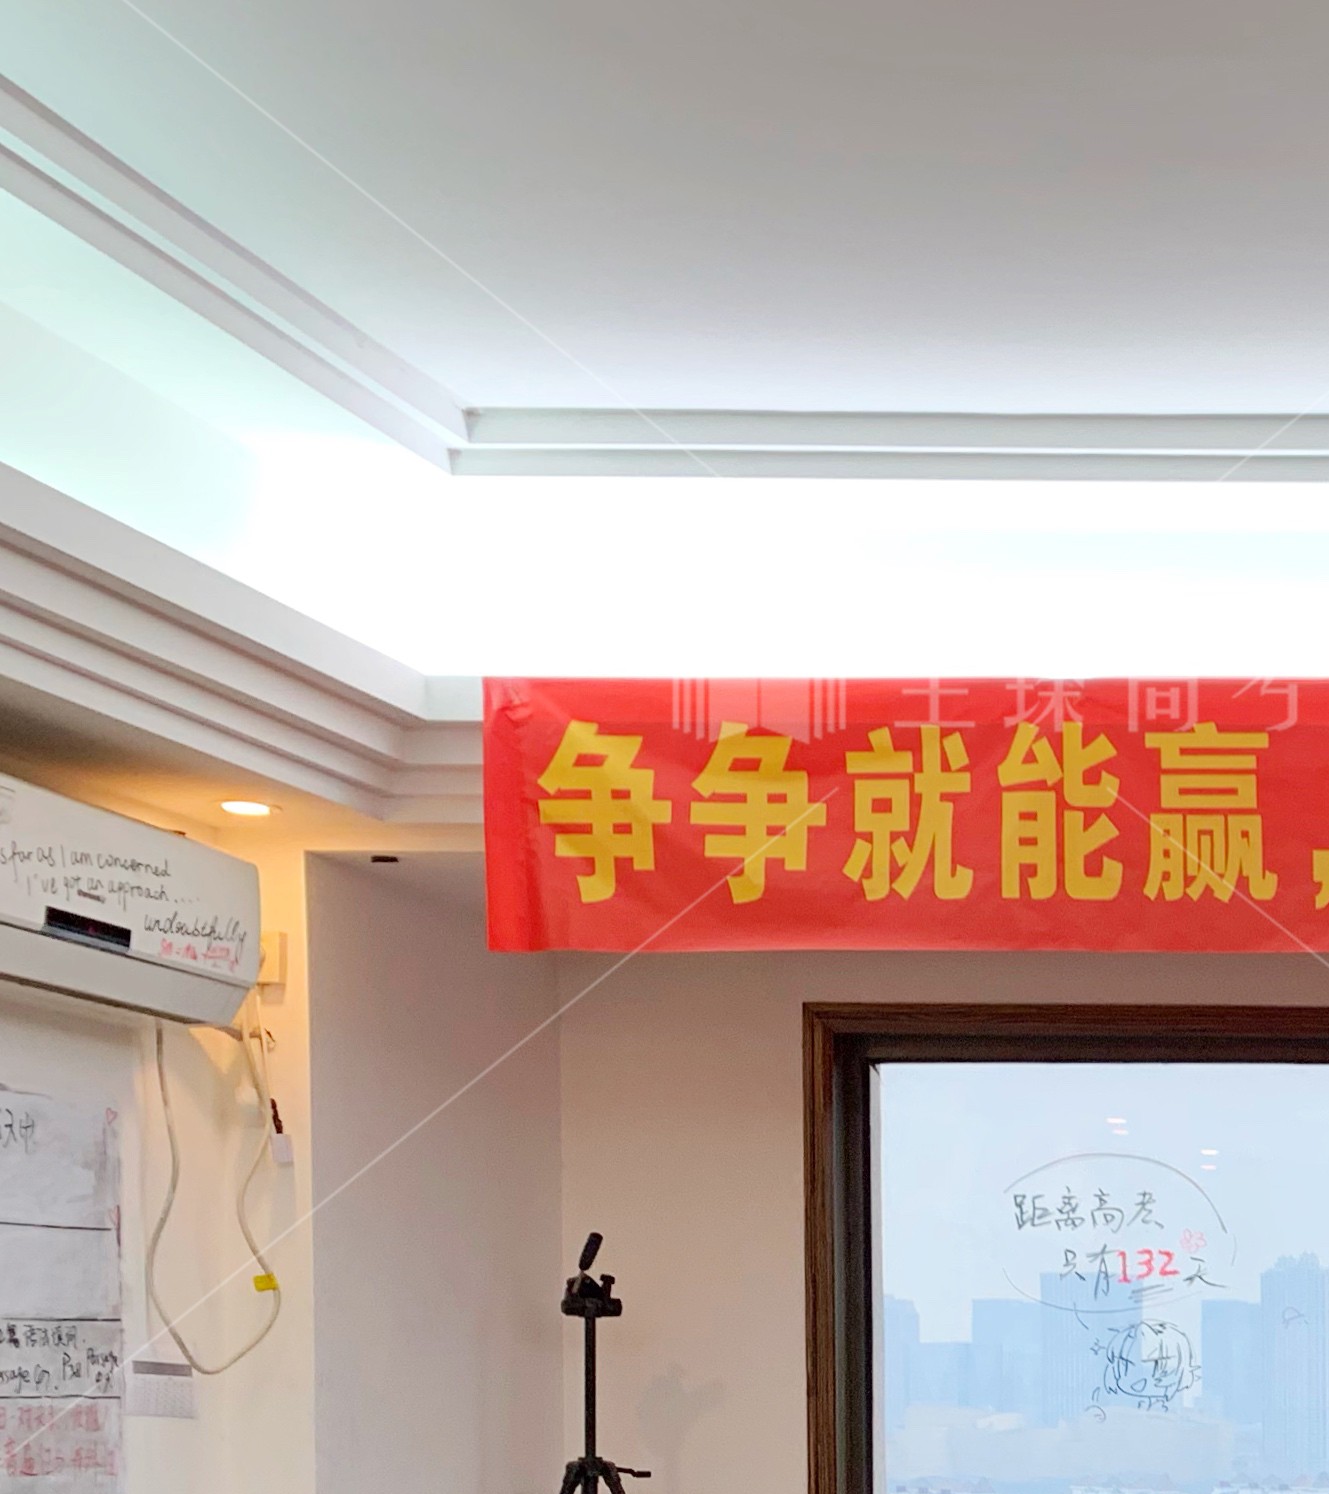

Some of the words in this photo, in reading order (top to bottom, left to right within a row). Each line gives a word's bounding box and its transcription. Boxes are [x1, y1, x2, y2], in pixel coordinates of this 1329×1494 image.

[97, 852, 171, 878] concerned
[1013, 1186, 1165, 1234] 距离高考
